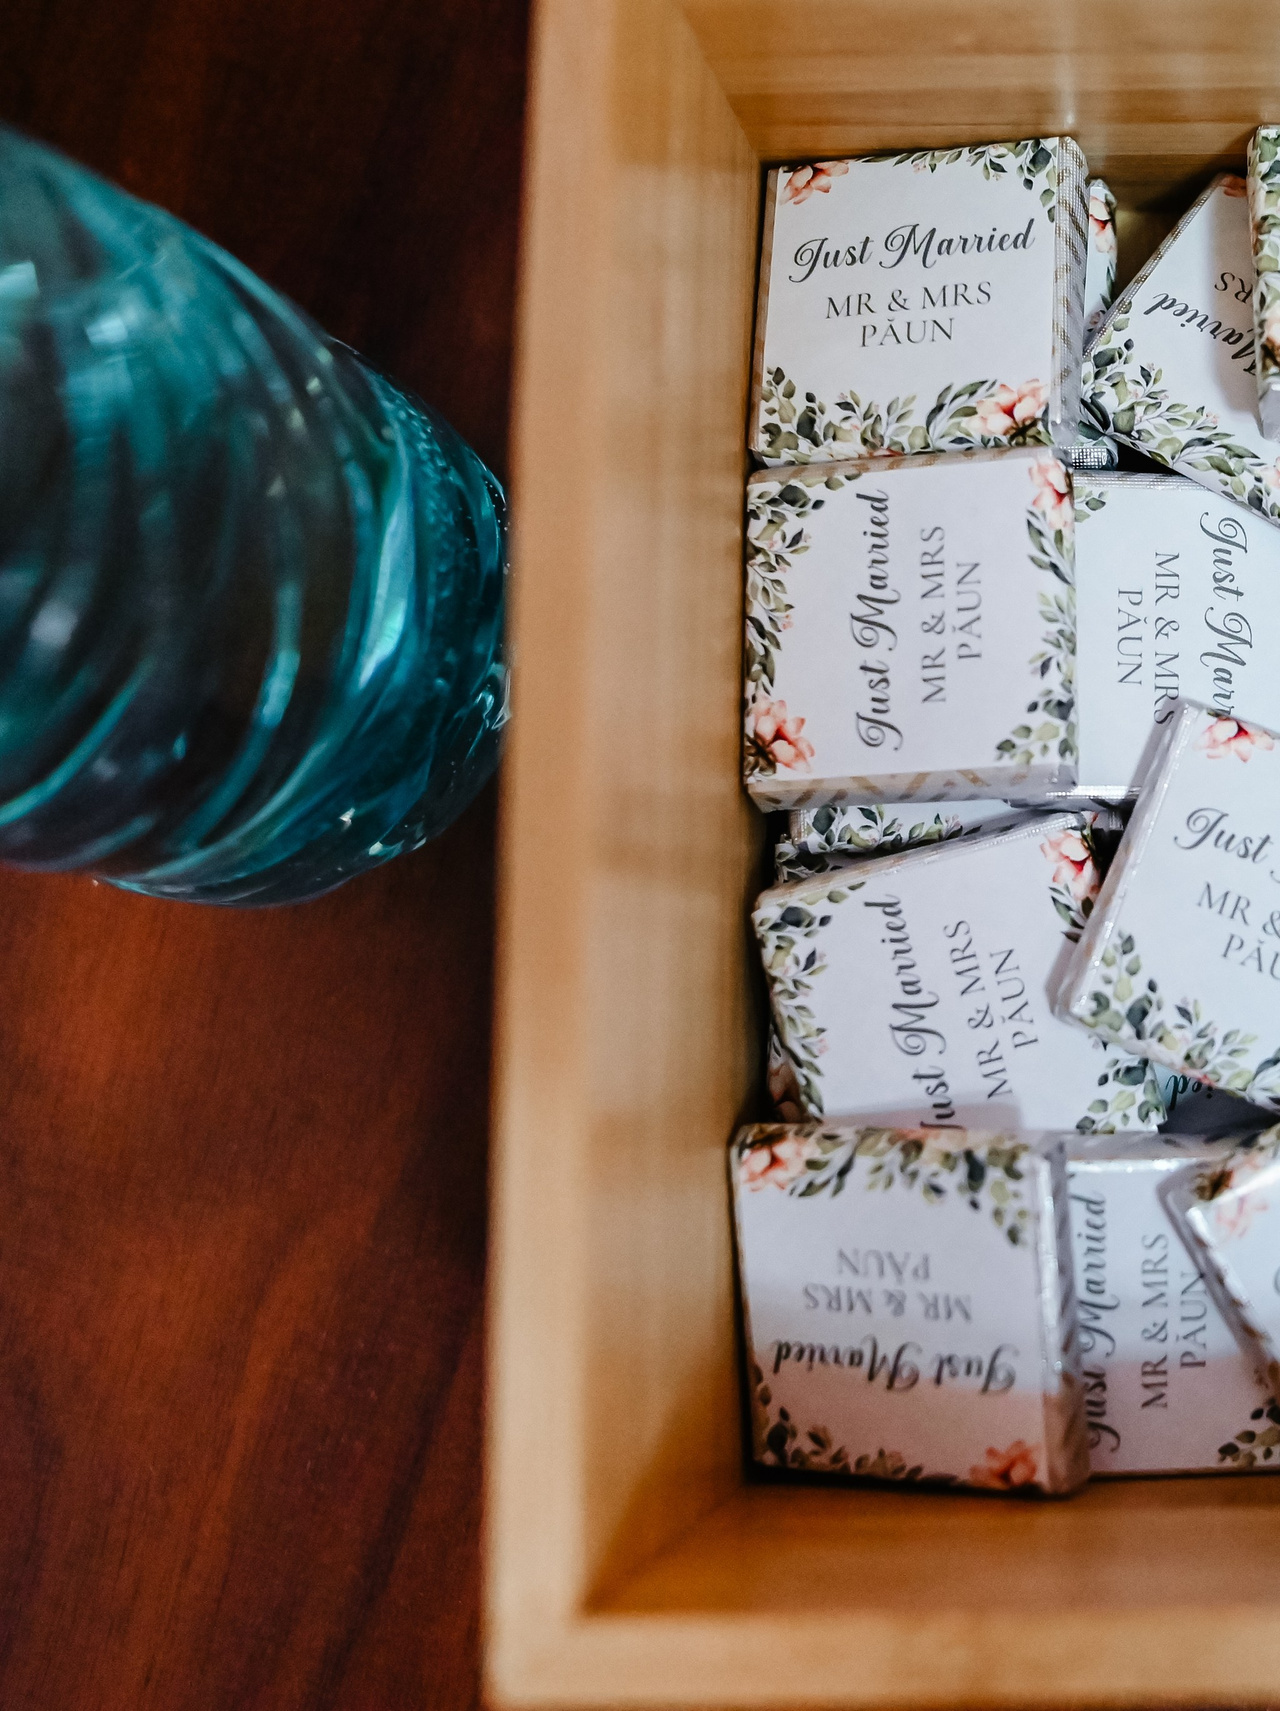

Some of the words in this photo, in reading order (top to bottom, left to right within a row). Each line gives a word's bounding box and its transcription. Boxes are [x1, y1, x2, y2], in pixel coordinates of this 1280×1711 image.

[788, 237, 874, 283] Just
[879, 218, 1036, 270] Married
[825, 293, 877, 320] MR
[888, 289, 911, 312] &
[921, 281, 992, 310] MRS
[1214, 271, 1254, 304] RS
[850, 488, 901, 652] Married
[920, 526, 945, 599] MRS
[1154, 551, 1181, 606] MR
[1199, 511, 1248, 602] Just
[921, 610, 946, 635] &
[1153, 616, 1180, 641] &
[921, 648, 947, 704] MR
[1154, 651, 1181, 726] MRS
[855, 659, 903, 751] Just
[1174, 807, 1274, 863] Just
[1197, 882, 1251, 927] MR
[864, 893, 947, 1057] Married
[943, 920, 987, 996] MRS
[968, 1003, 995, 1030] &
[977, 1041, 1014, 1099] MR
[803, 1284, 873, 1313] MRS
[1070, 1189, 1121, 1358] Married
[1140, 1233, 1169, 1308] MRS
[881, 1289, 907, 1317] &
[917, 1292, 973, 1322] MR
[1141, 1318, 1169, 1344] &
[774, 1334, 920, 1391] Married
[933, 1343, 1020, 1394] Just
[1140, 1355, 1169, 1410] MR
